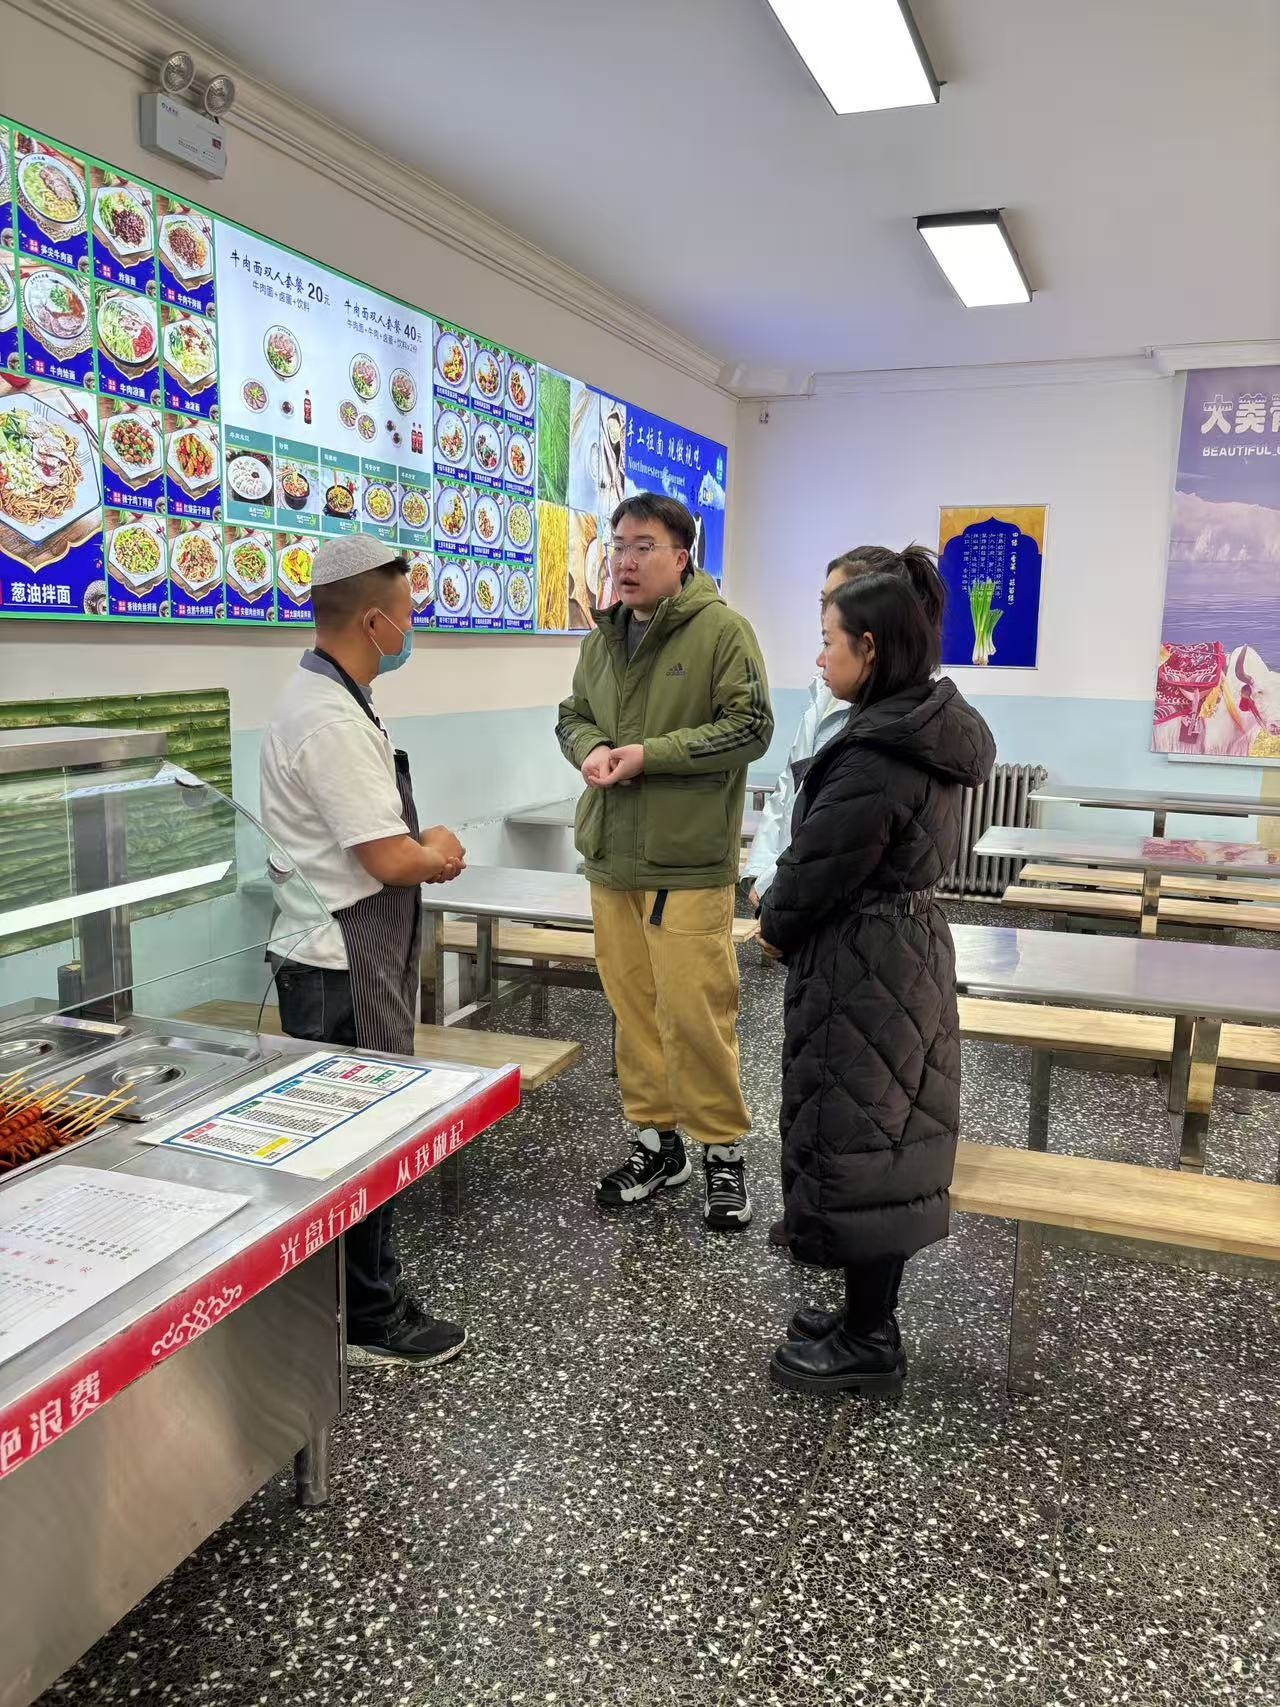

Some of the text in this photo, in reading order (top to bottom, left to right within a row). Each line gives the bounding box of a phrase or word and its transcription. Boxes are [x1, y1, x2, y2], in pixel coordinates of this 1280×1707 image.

[230, 249, 304, 294] 牛肉面双人套餐
[10, 582, 71, 605] 葱油拌面
[279, 1187, 368, 1275] 光盘行动
[395, 1119, 465, 1190] 从我做起
